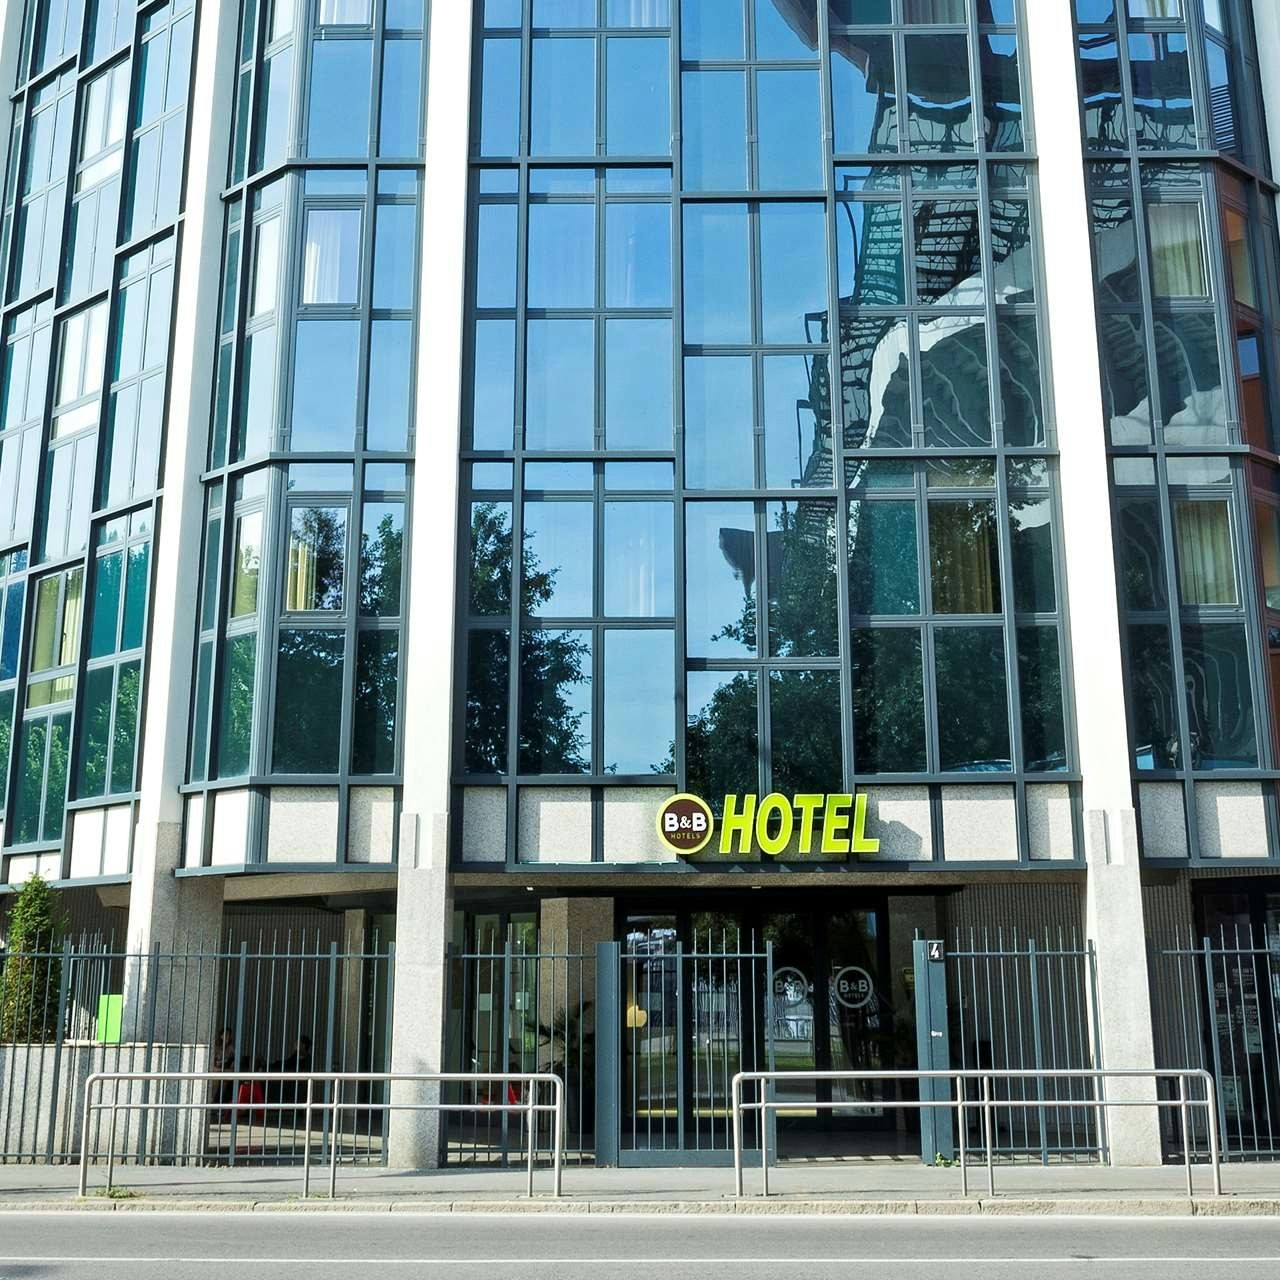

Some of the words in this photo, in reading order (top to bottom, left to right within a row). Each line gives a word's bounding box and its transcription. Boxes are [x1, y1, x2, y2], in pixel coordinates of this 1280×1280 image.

[664, 812, 707, 833] B&B
[718, 792, 881, 856] HOTEL
[930, 943, 940, 960] 4
[775, 980, 804, 993] BB
[839, 979, 868, 993] B&B
